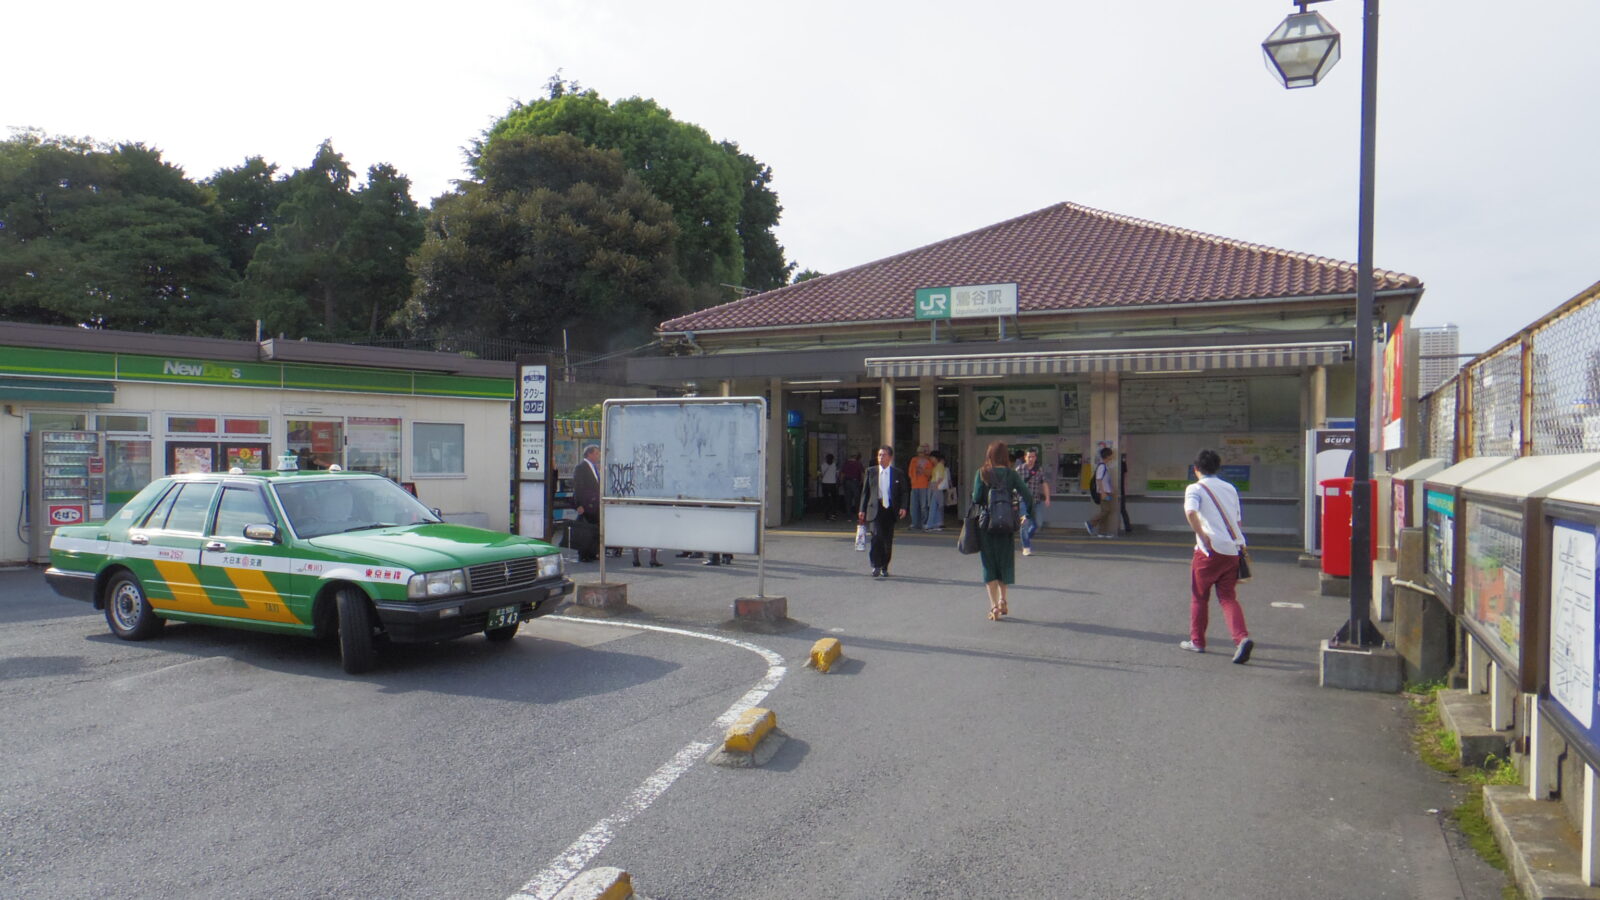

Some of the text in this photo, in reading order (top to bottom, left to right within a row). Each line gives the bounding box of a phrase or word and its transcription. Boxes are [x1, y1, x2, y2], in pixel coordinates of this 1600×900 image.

[919, 293, 947, 310] JR
[163, 360, 241, 379] NewDays
[523, 388, 545, 399] タクシー
[524, 402, 544, 412] のりば
[54, 510, 78, 520] たばこ
[223, 556, 241, 565] 大日本
